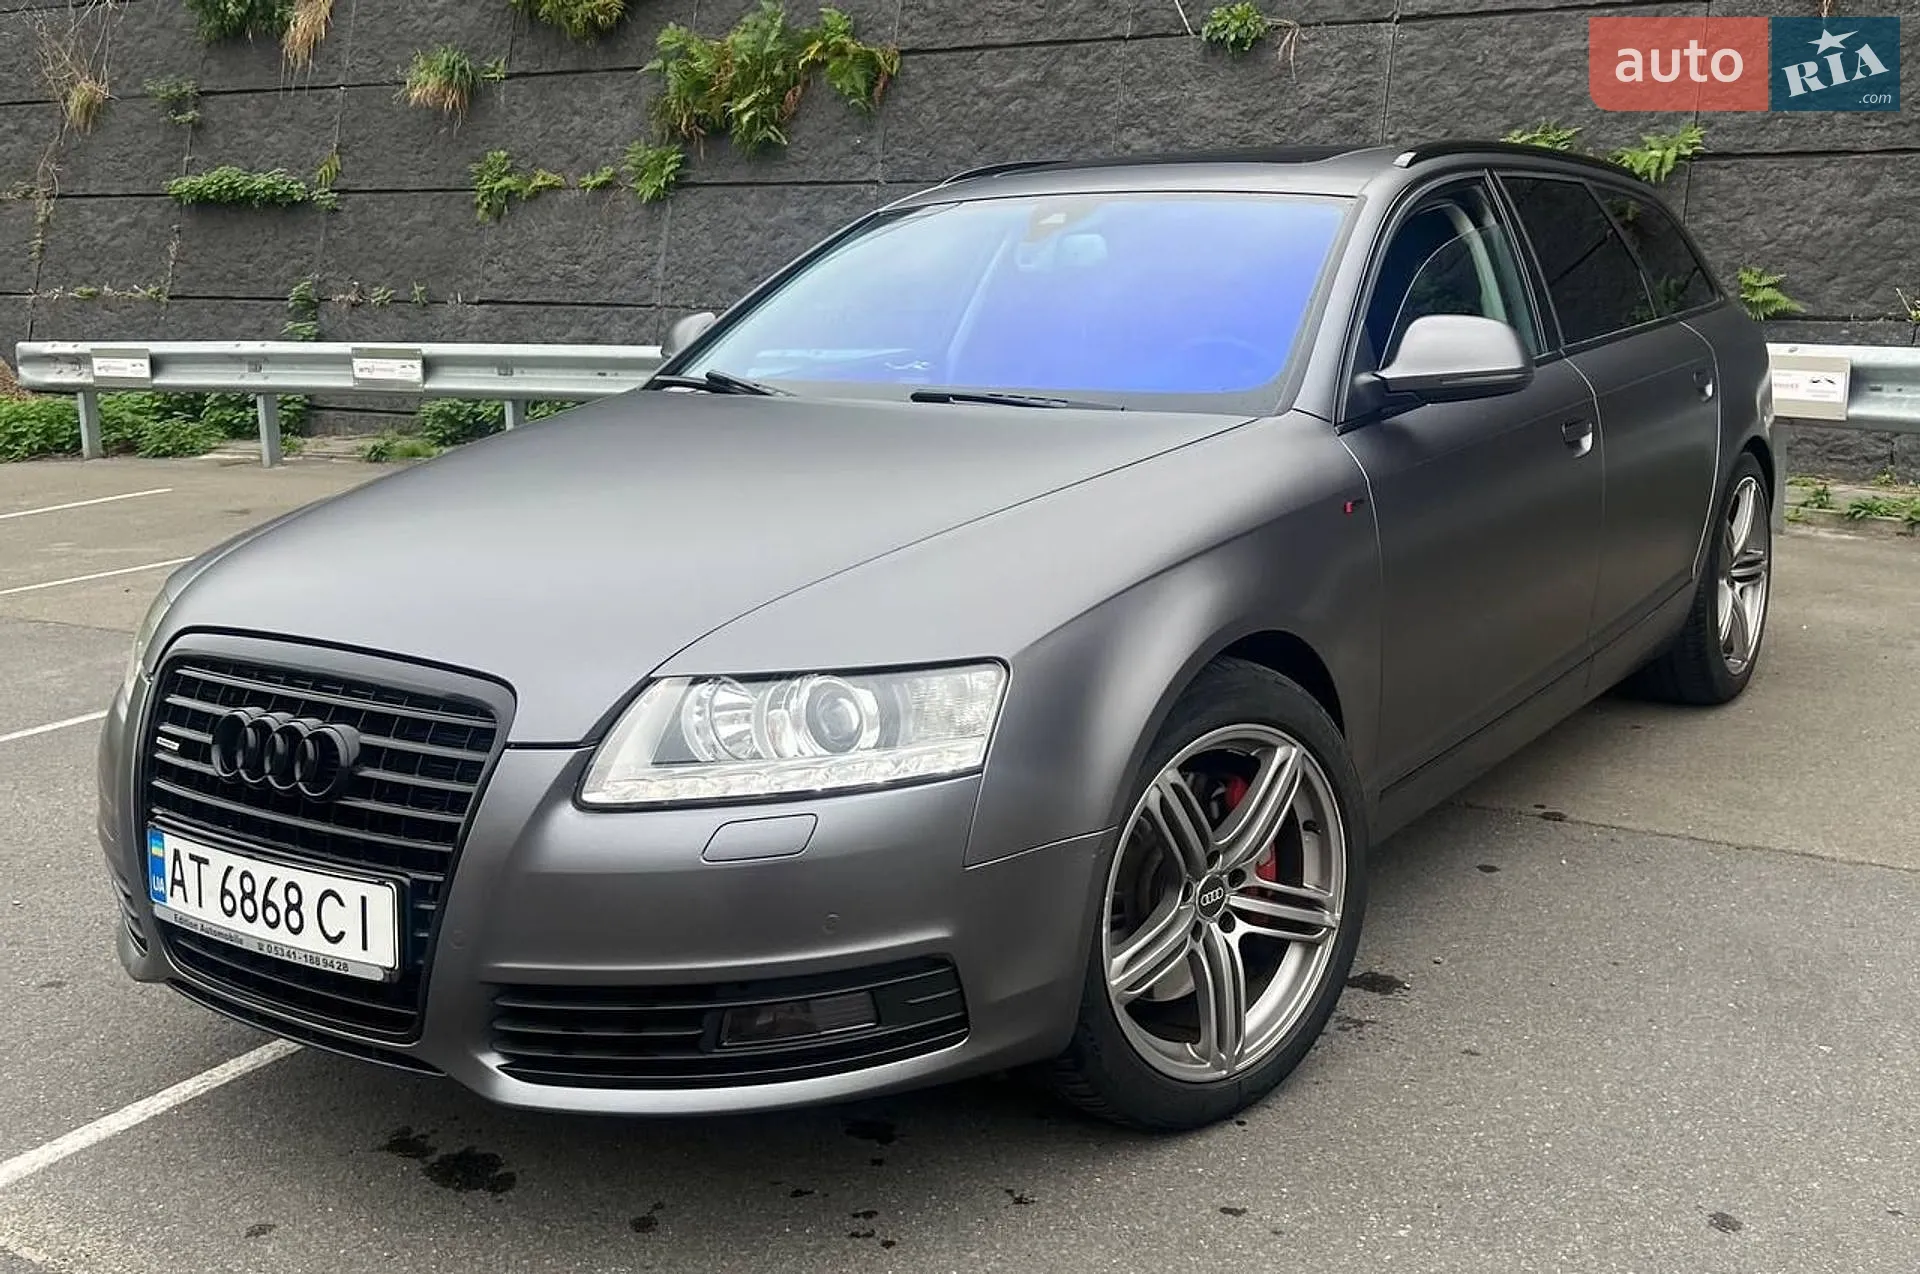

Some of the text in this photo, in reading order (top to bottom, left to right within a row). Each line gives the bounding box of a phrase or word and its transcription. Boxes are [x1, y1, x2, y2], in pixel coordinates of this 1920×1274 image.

[153, 875, 165, 894] UA
[170, 847, 369, 952] AT 6868 CI
